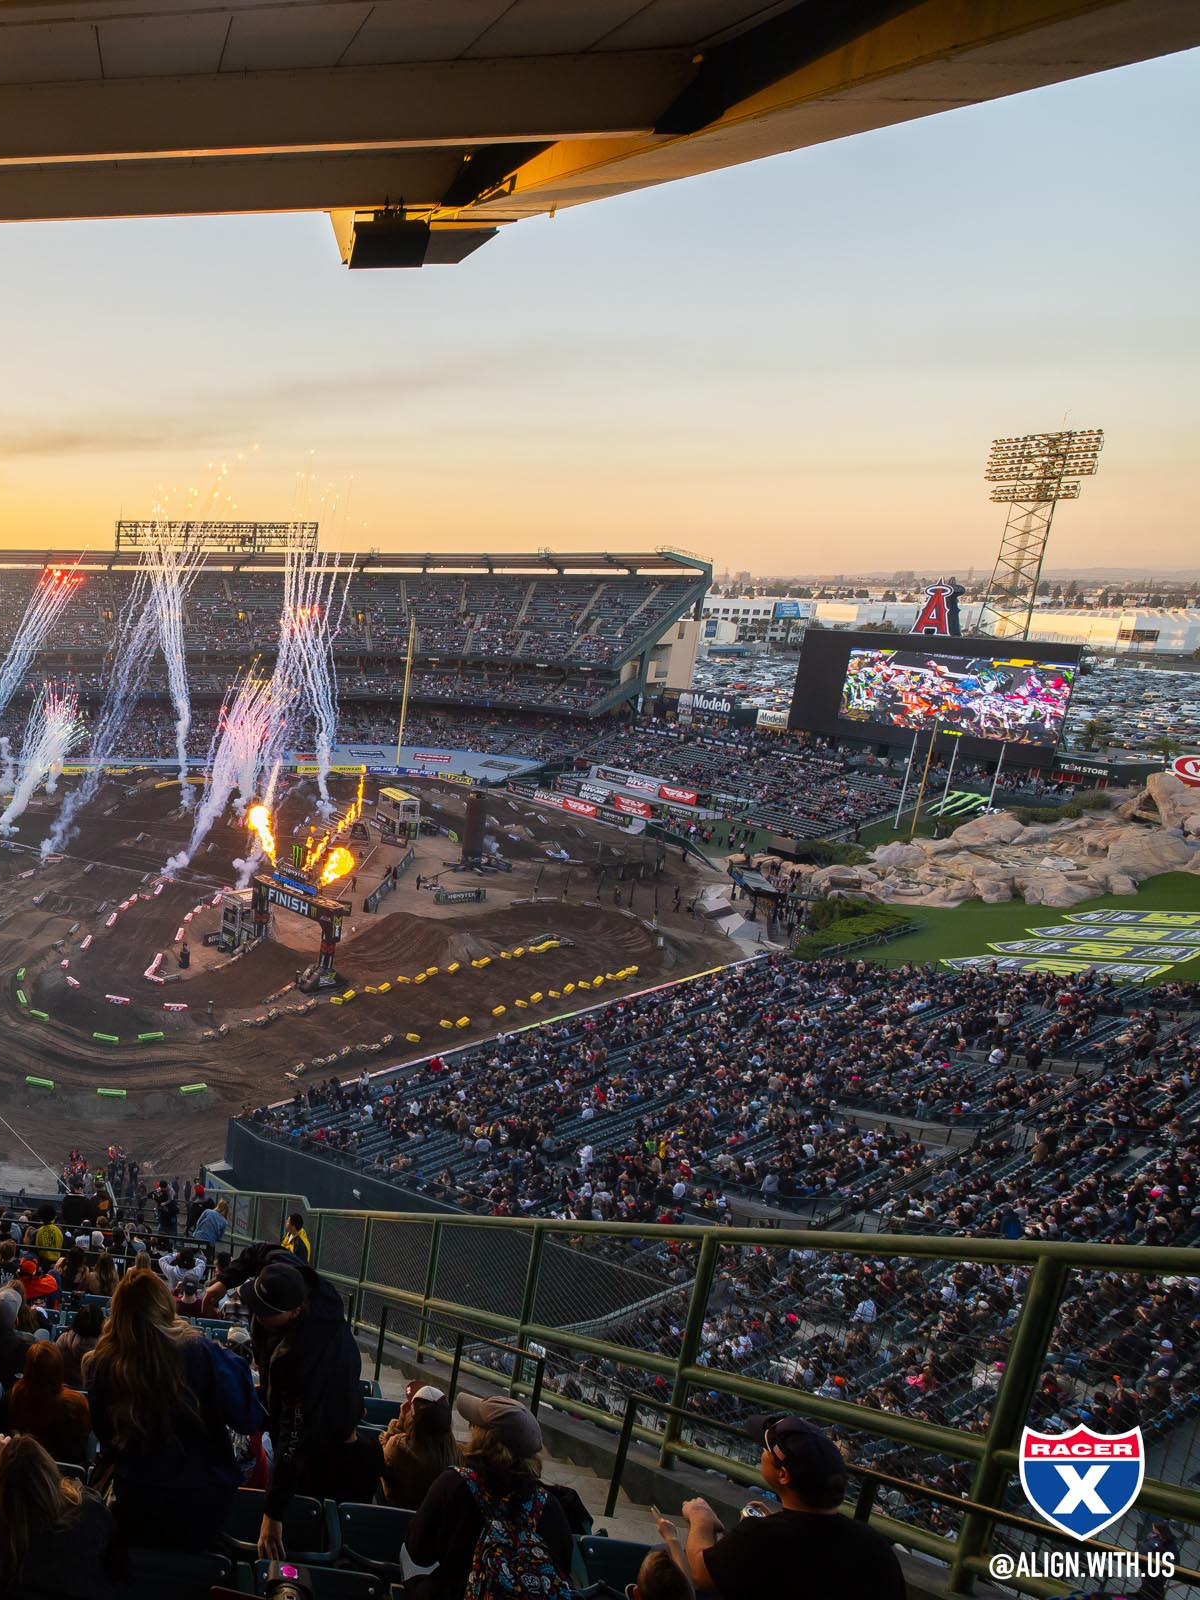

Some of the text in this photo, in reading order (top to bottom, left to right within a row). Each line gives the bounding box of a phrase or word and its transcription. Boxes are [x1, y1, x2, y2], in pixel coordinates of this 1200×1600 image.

[693, 694, 731, 712] Modelo
[760, 712, 786, 724] Modelo
[406, 768, 437, 776] FALKEN
[1059, 763, 1109, 776] TEAM STORE
[268, 889, 309, 916] FINISH
